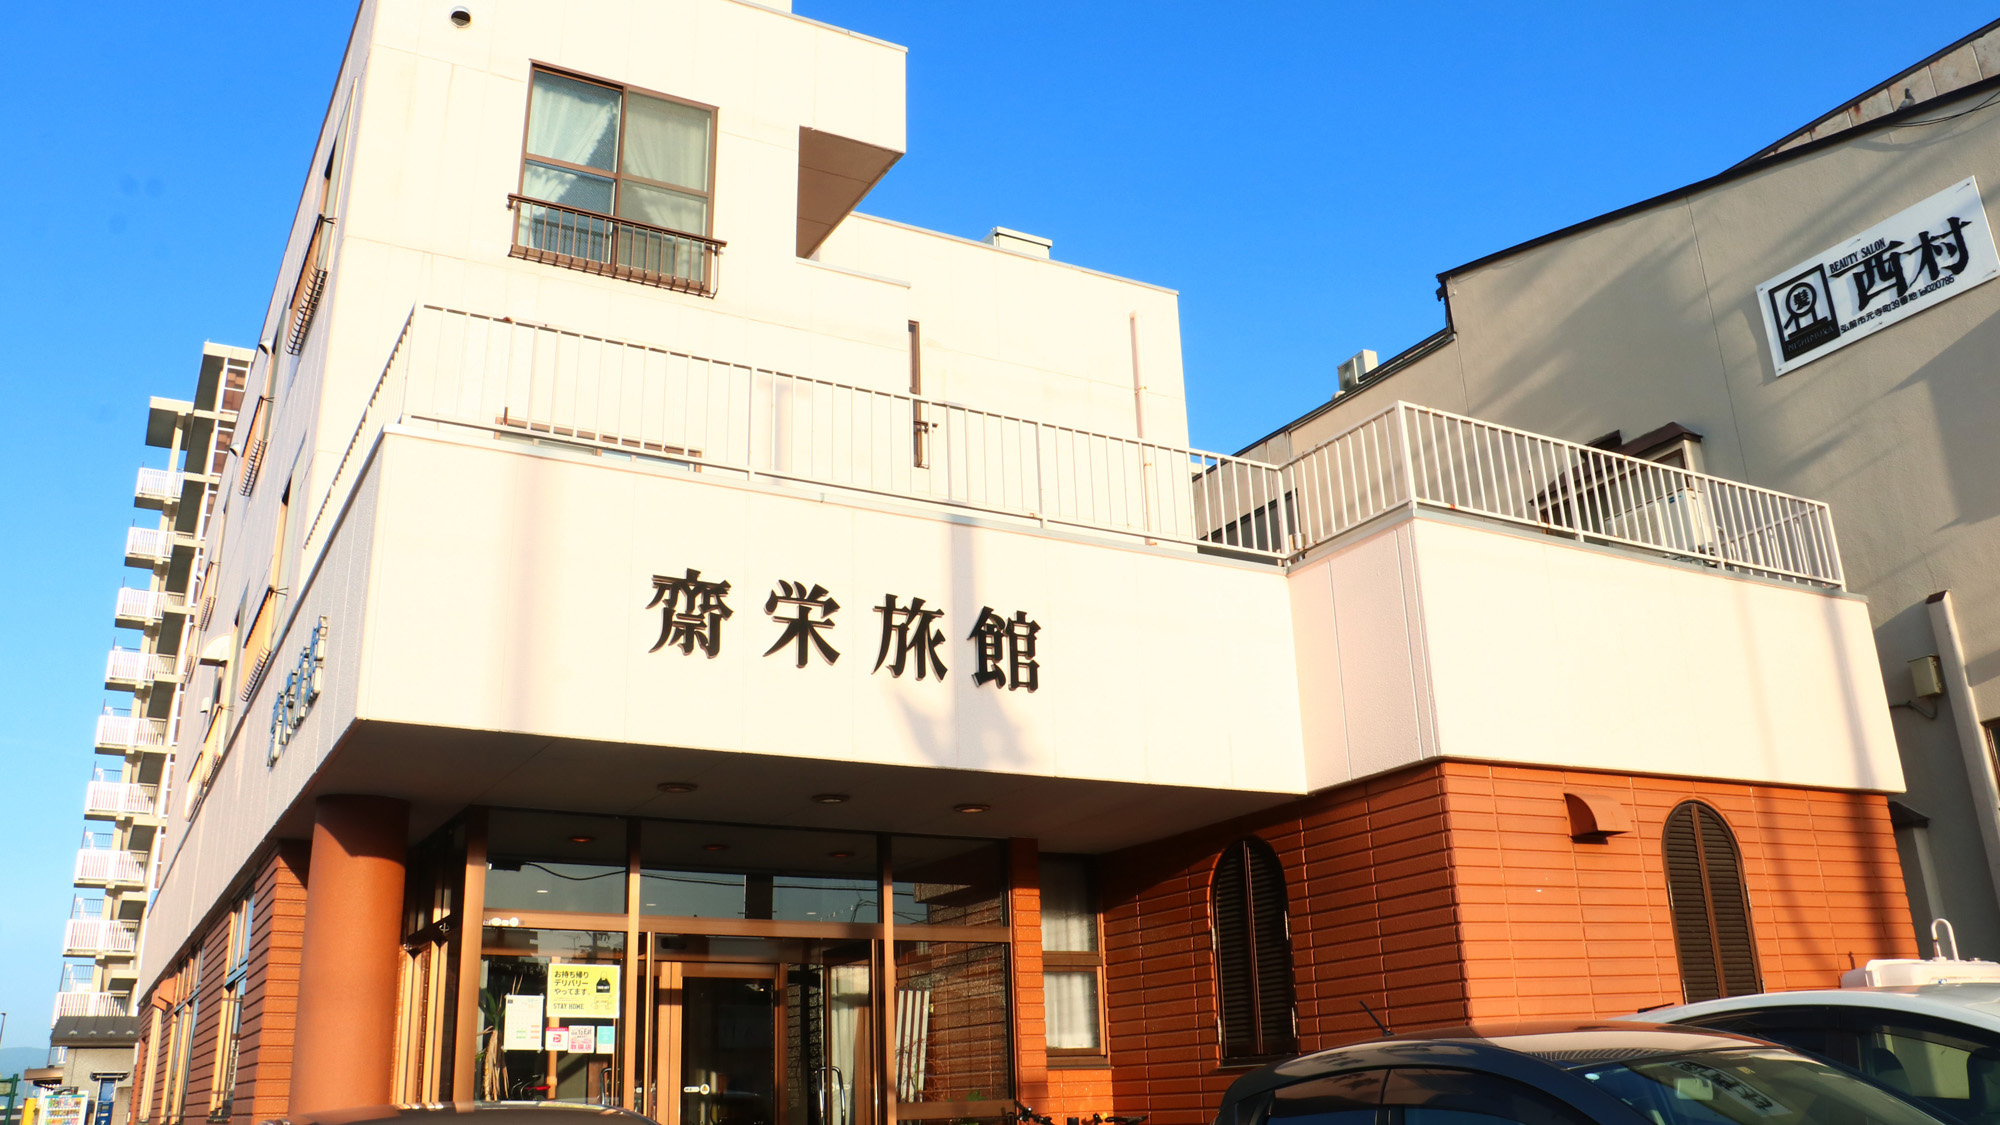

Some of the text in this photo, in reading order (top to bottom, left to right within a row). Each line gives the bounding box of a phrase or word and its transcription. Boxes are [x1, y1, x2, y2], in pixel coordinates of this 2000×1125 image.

[1828, 238, 1887, 275] BEAUTY SALON
[1828, 217, 1972, 312] 西村
[554, 971, 589, 979] お持ち帰り
[554, 979, 589, 987] デリバリー
